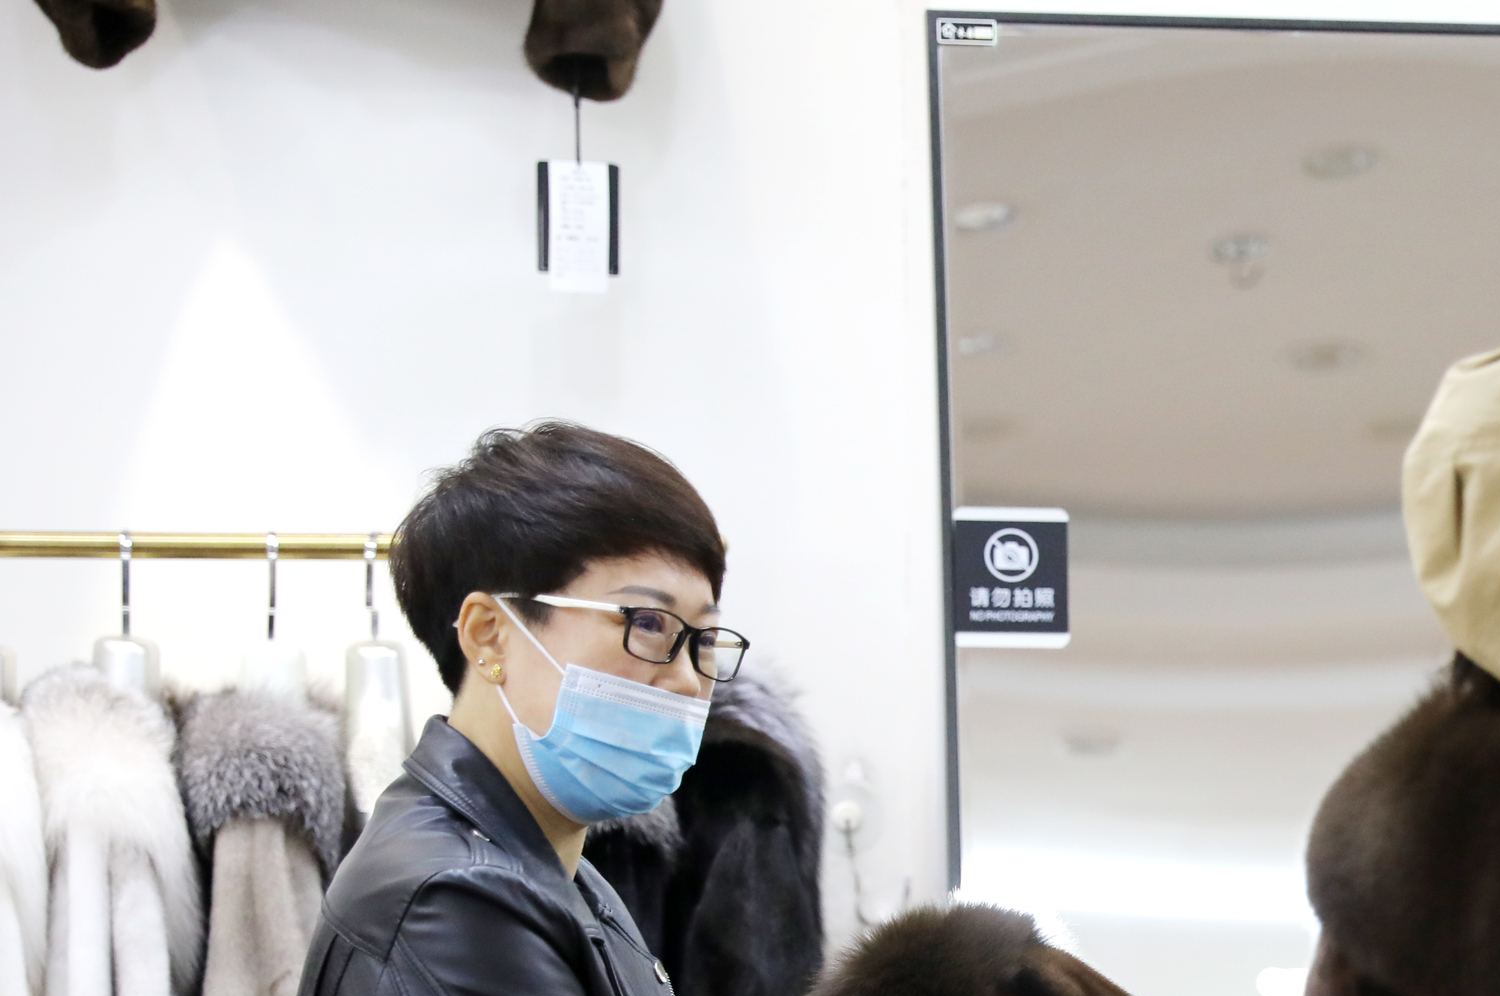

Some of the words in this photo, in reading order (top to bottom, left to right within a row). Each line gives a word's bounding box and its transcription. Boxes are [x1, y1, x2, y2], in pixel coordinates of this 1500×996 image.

[969, 586, 1055, 608] 请勿拍照
[969, 609, 985, 622] NO
[986, 609, 1055, 623] PHOTOGRAPHY
